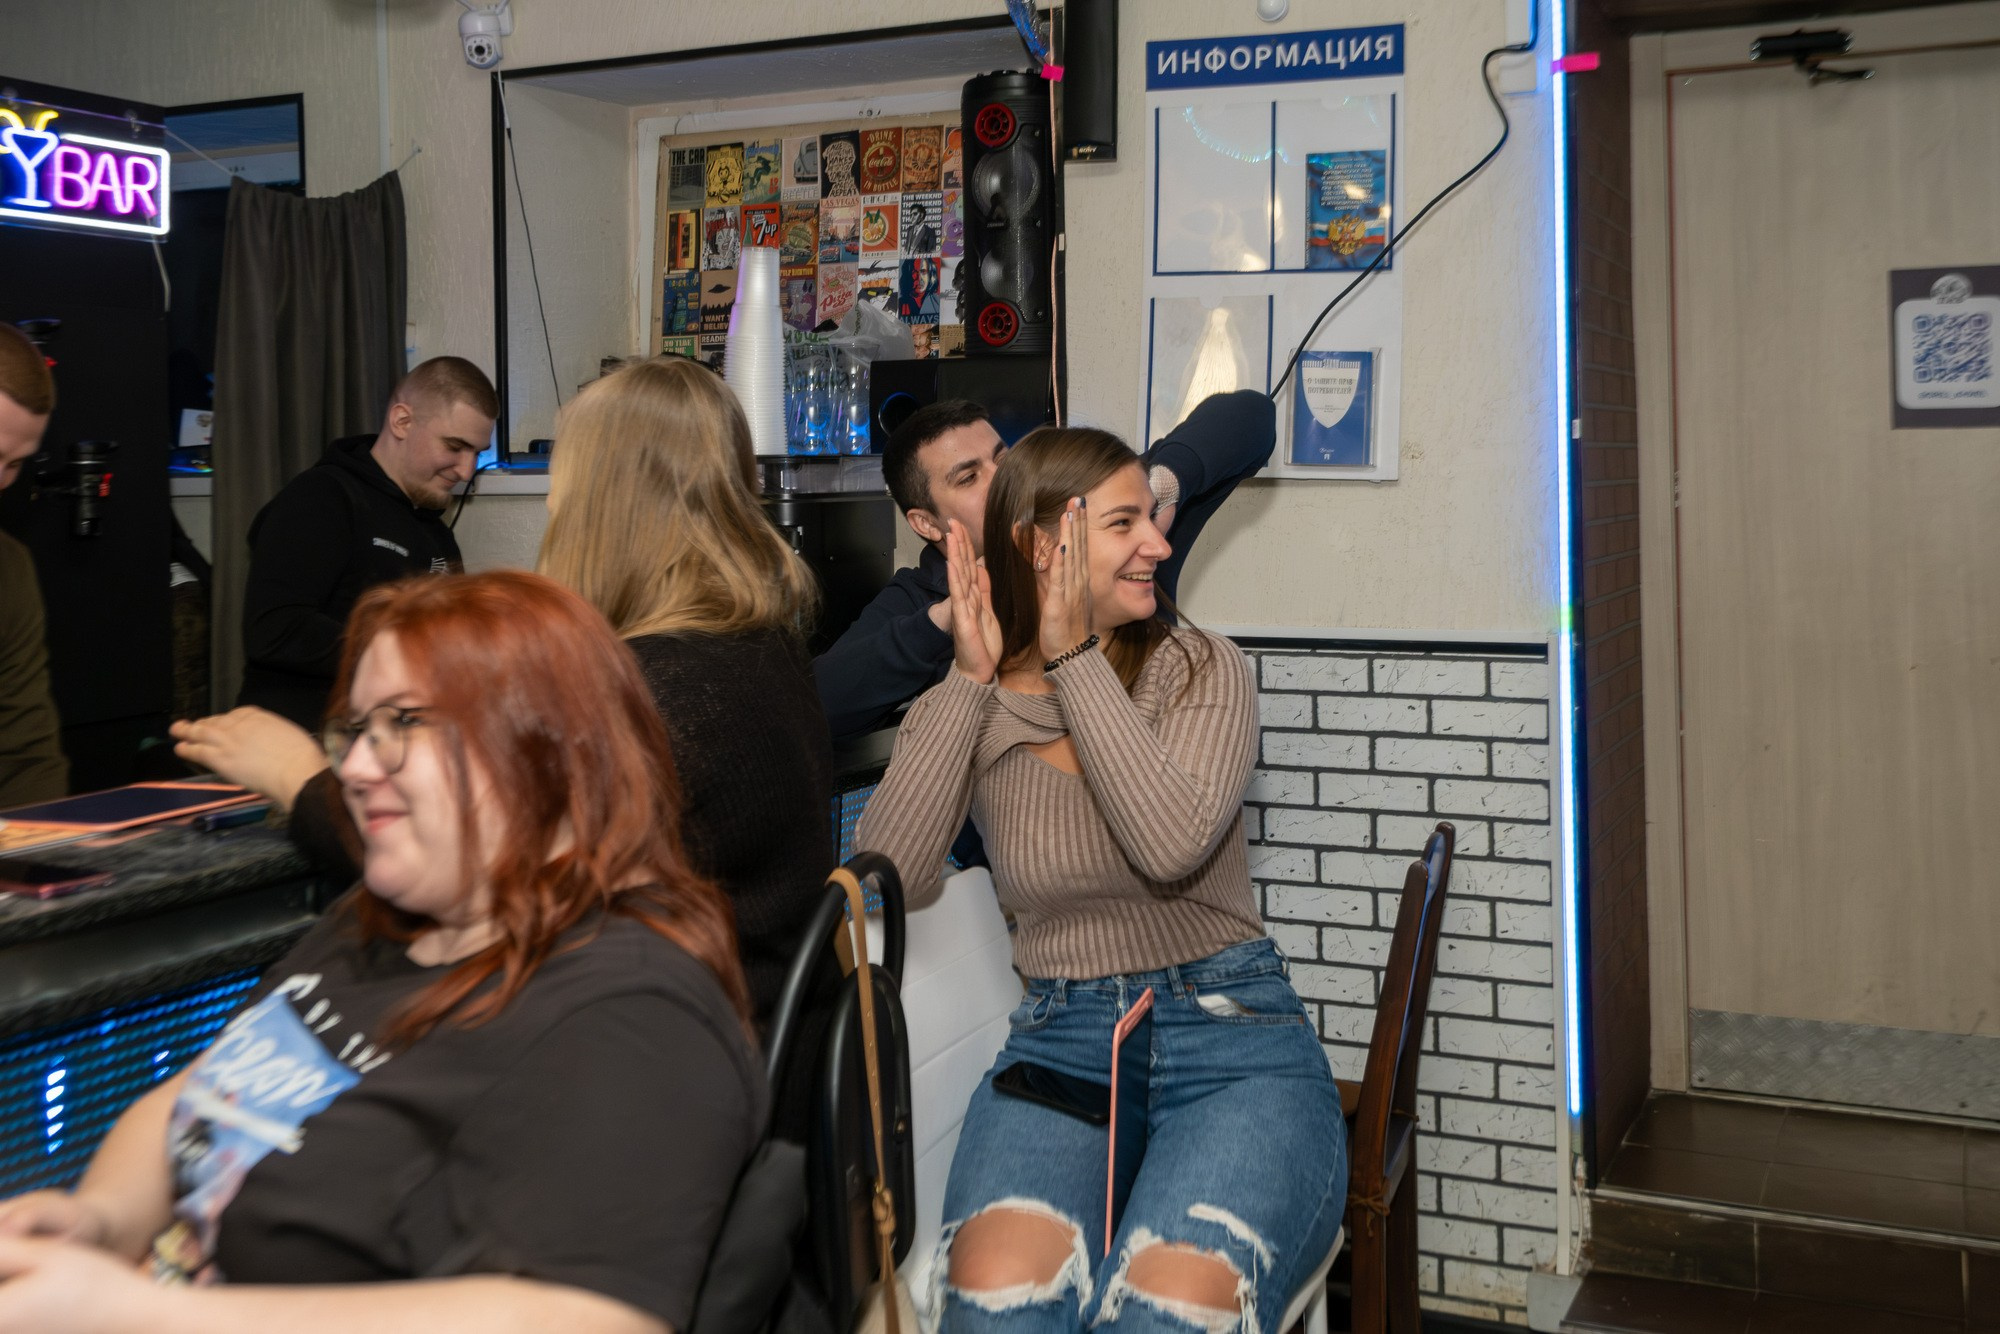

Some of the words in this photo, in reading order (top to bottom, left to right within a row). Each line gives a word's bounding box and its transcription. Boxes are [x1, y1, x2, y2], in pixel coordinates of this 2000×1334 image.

[1157, 35, 1395, 75] ИНФОРМАЦИЯ
[869, 130, 893, 143] DRINK
[672, 151, 685, 165] THE
[689, 149, 705, 164] CAR
[873, 178, 899, 192] BOTTLE
[782, 189, 818, 200] BEETLE
[820, 199, 834, 207] LAS
[836, 197, 860, 206] VEGAS
[820, 291, 853, 311] Pizza
[705, 314, 723, 322] WANT
[899, 315, 940, 325] ALWAYS
[675, 339, 692, 347] TIME
[1307, 386, 1352, 394] ПОТРЕБИТЕЛЕЙ
